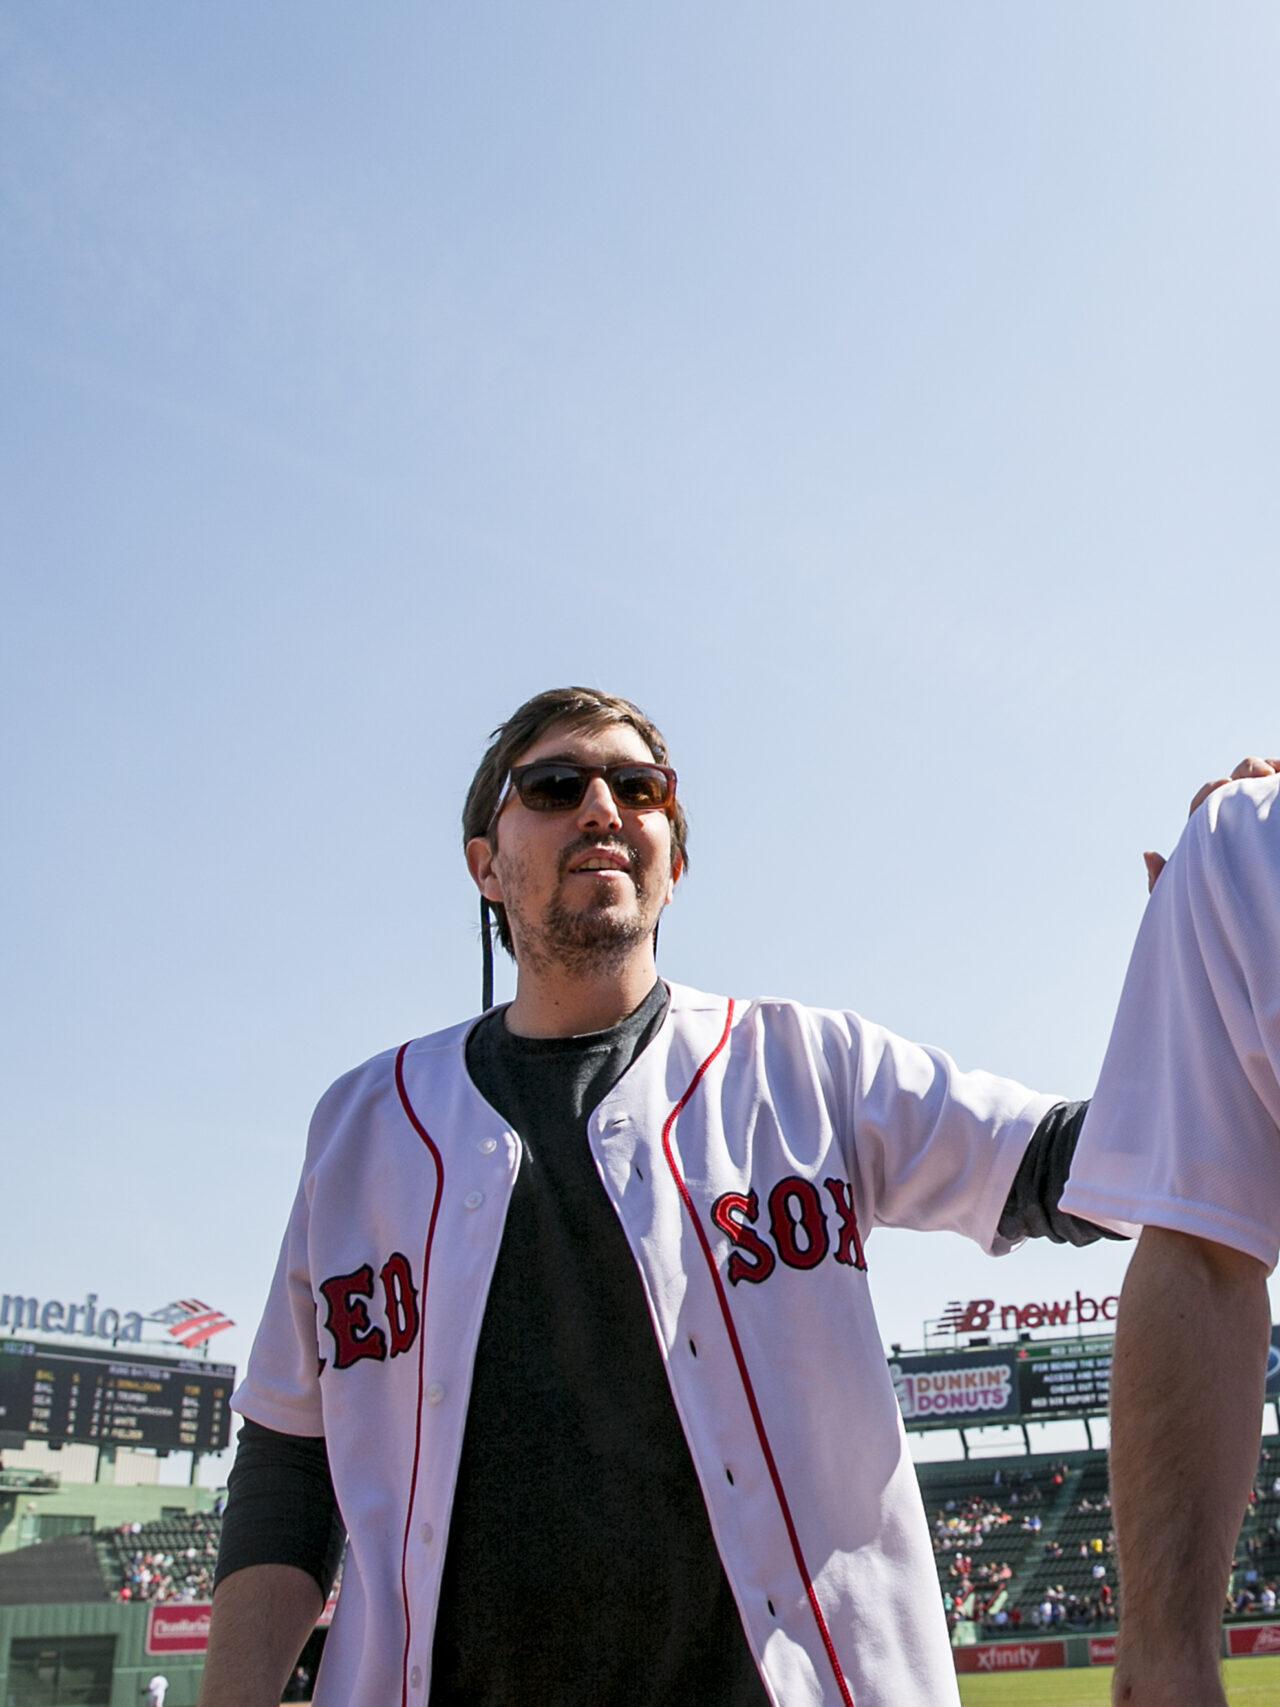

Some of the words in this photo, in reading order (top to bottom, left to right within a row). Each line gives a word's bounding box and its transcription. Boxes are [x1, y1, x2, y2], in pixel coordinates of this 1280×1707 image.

[710, 1175, 868, 1287] SOX
[316, 1251, 419, 1376] ED
[1000, 1300, 1070, 1330] new
[917, 1368, 1008, 1393] DUNKIN'
[917, 1389, 1006, 1411] DONUTS
[977, 1645, 1041, 1671] xfinity
